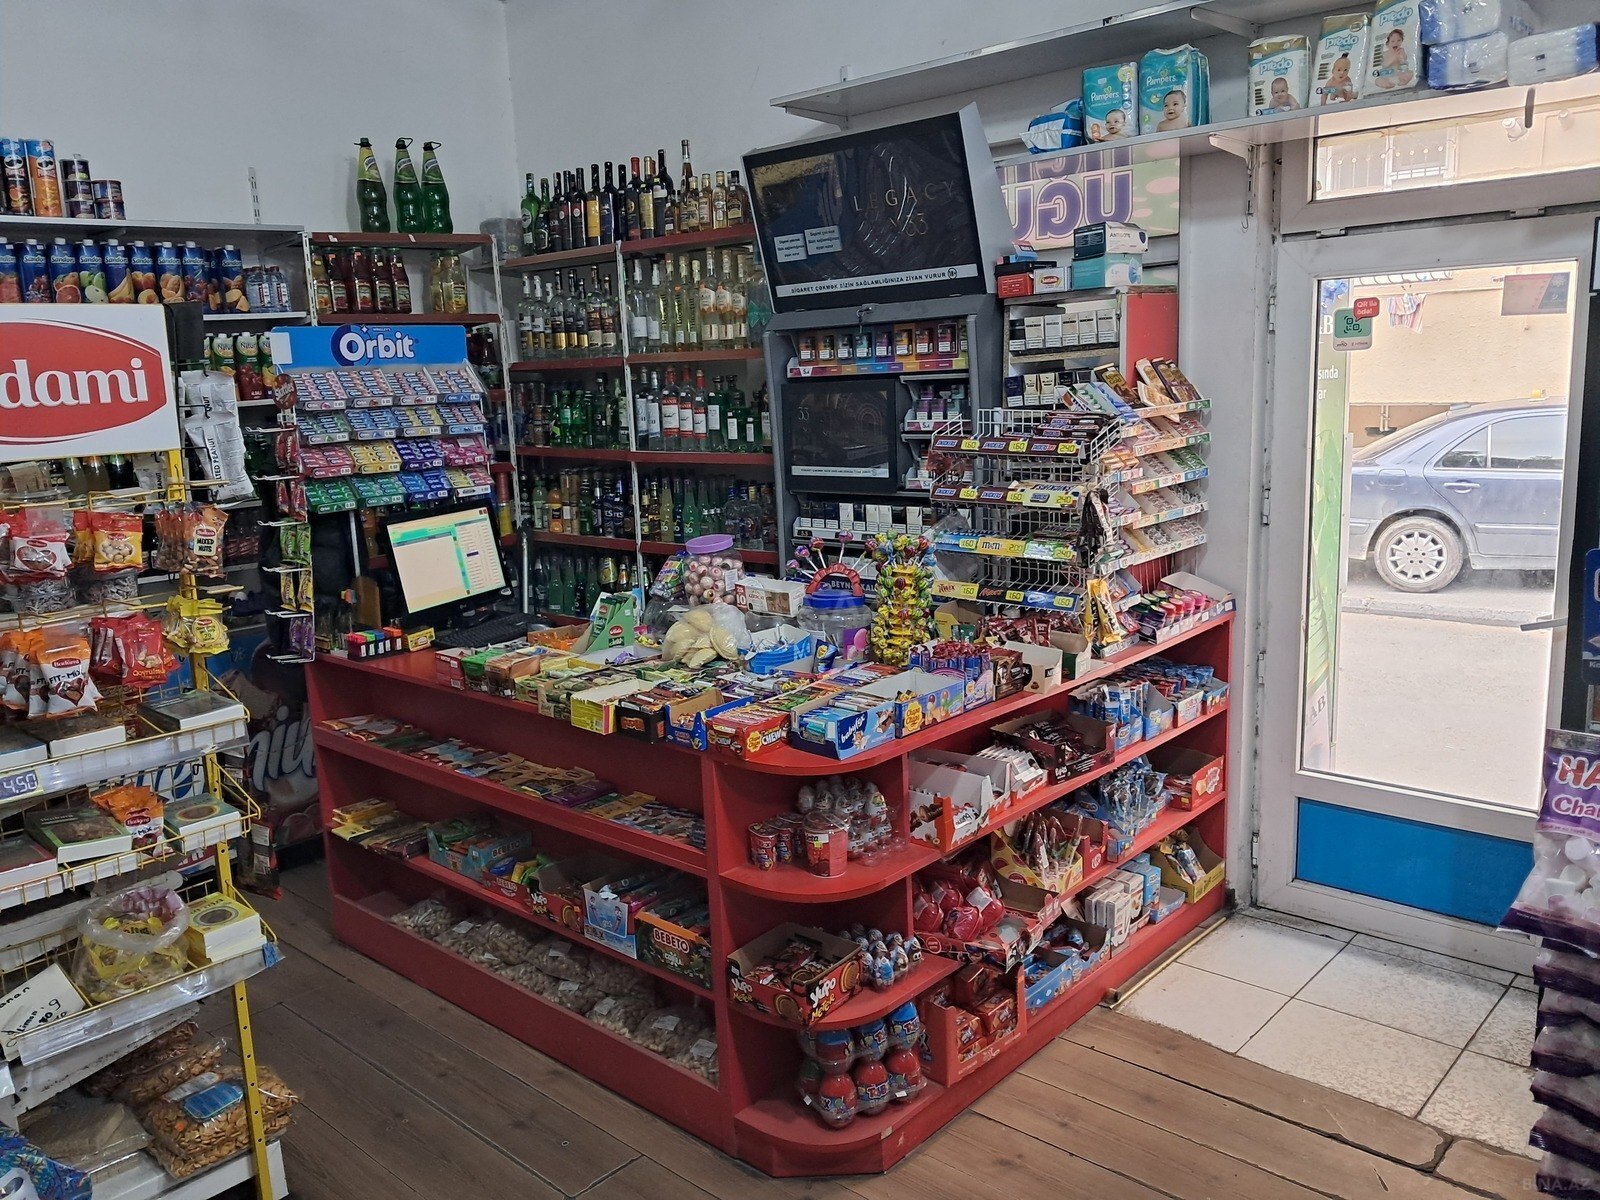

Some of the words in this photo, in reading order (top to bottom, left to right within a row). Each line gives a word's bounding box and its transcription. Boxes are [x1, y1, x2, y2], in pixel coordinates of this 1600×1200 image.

[1380, 6, 1413, 26] predo
[1326, 34, 1359, 50] predo
[1259, 57, 1293, 74] predo
[1147, 75, 1176, 86] Pampers
[1091, 92, 1119, 102] Pampers
[855, 276, 904, 287] SAĞLAMLIĞINIZA
[340, 331, 415, 362] Orbit
[0, 357, 149, 409] dami
[736, 594, 746, 605] 10
[655, 928, 690, 953] BEBETO
